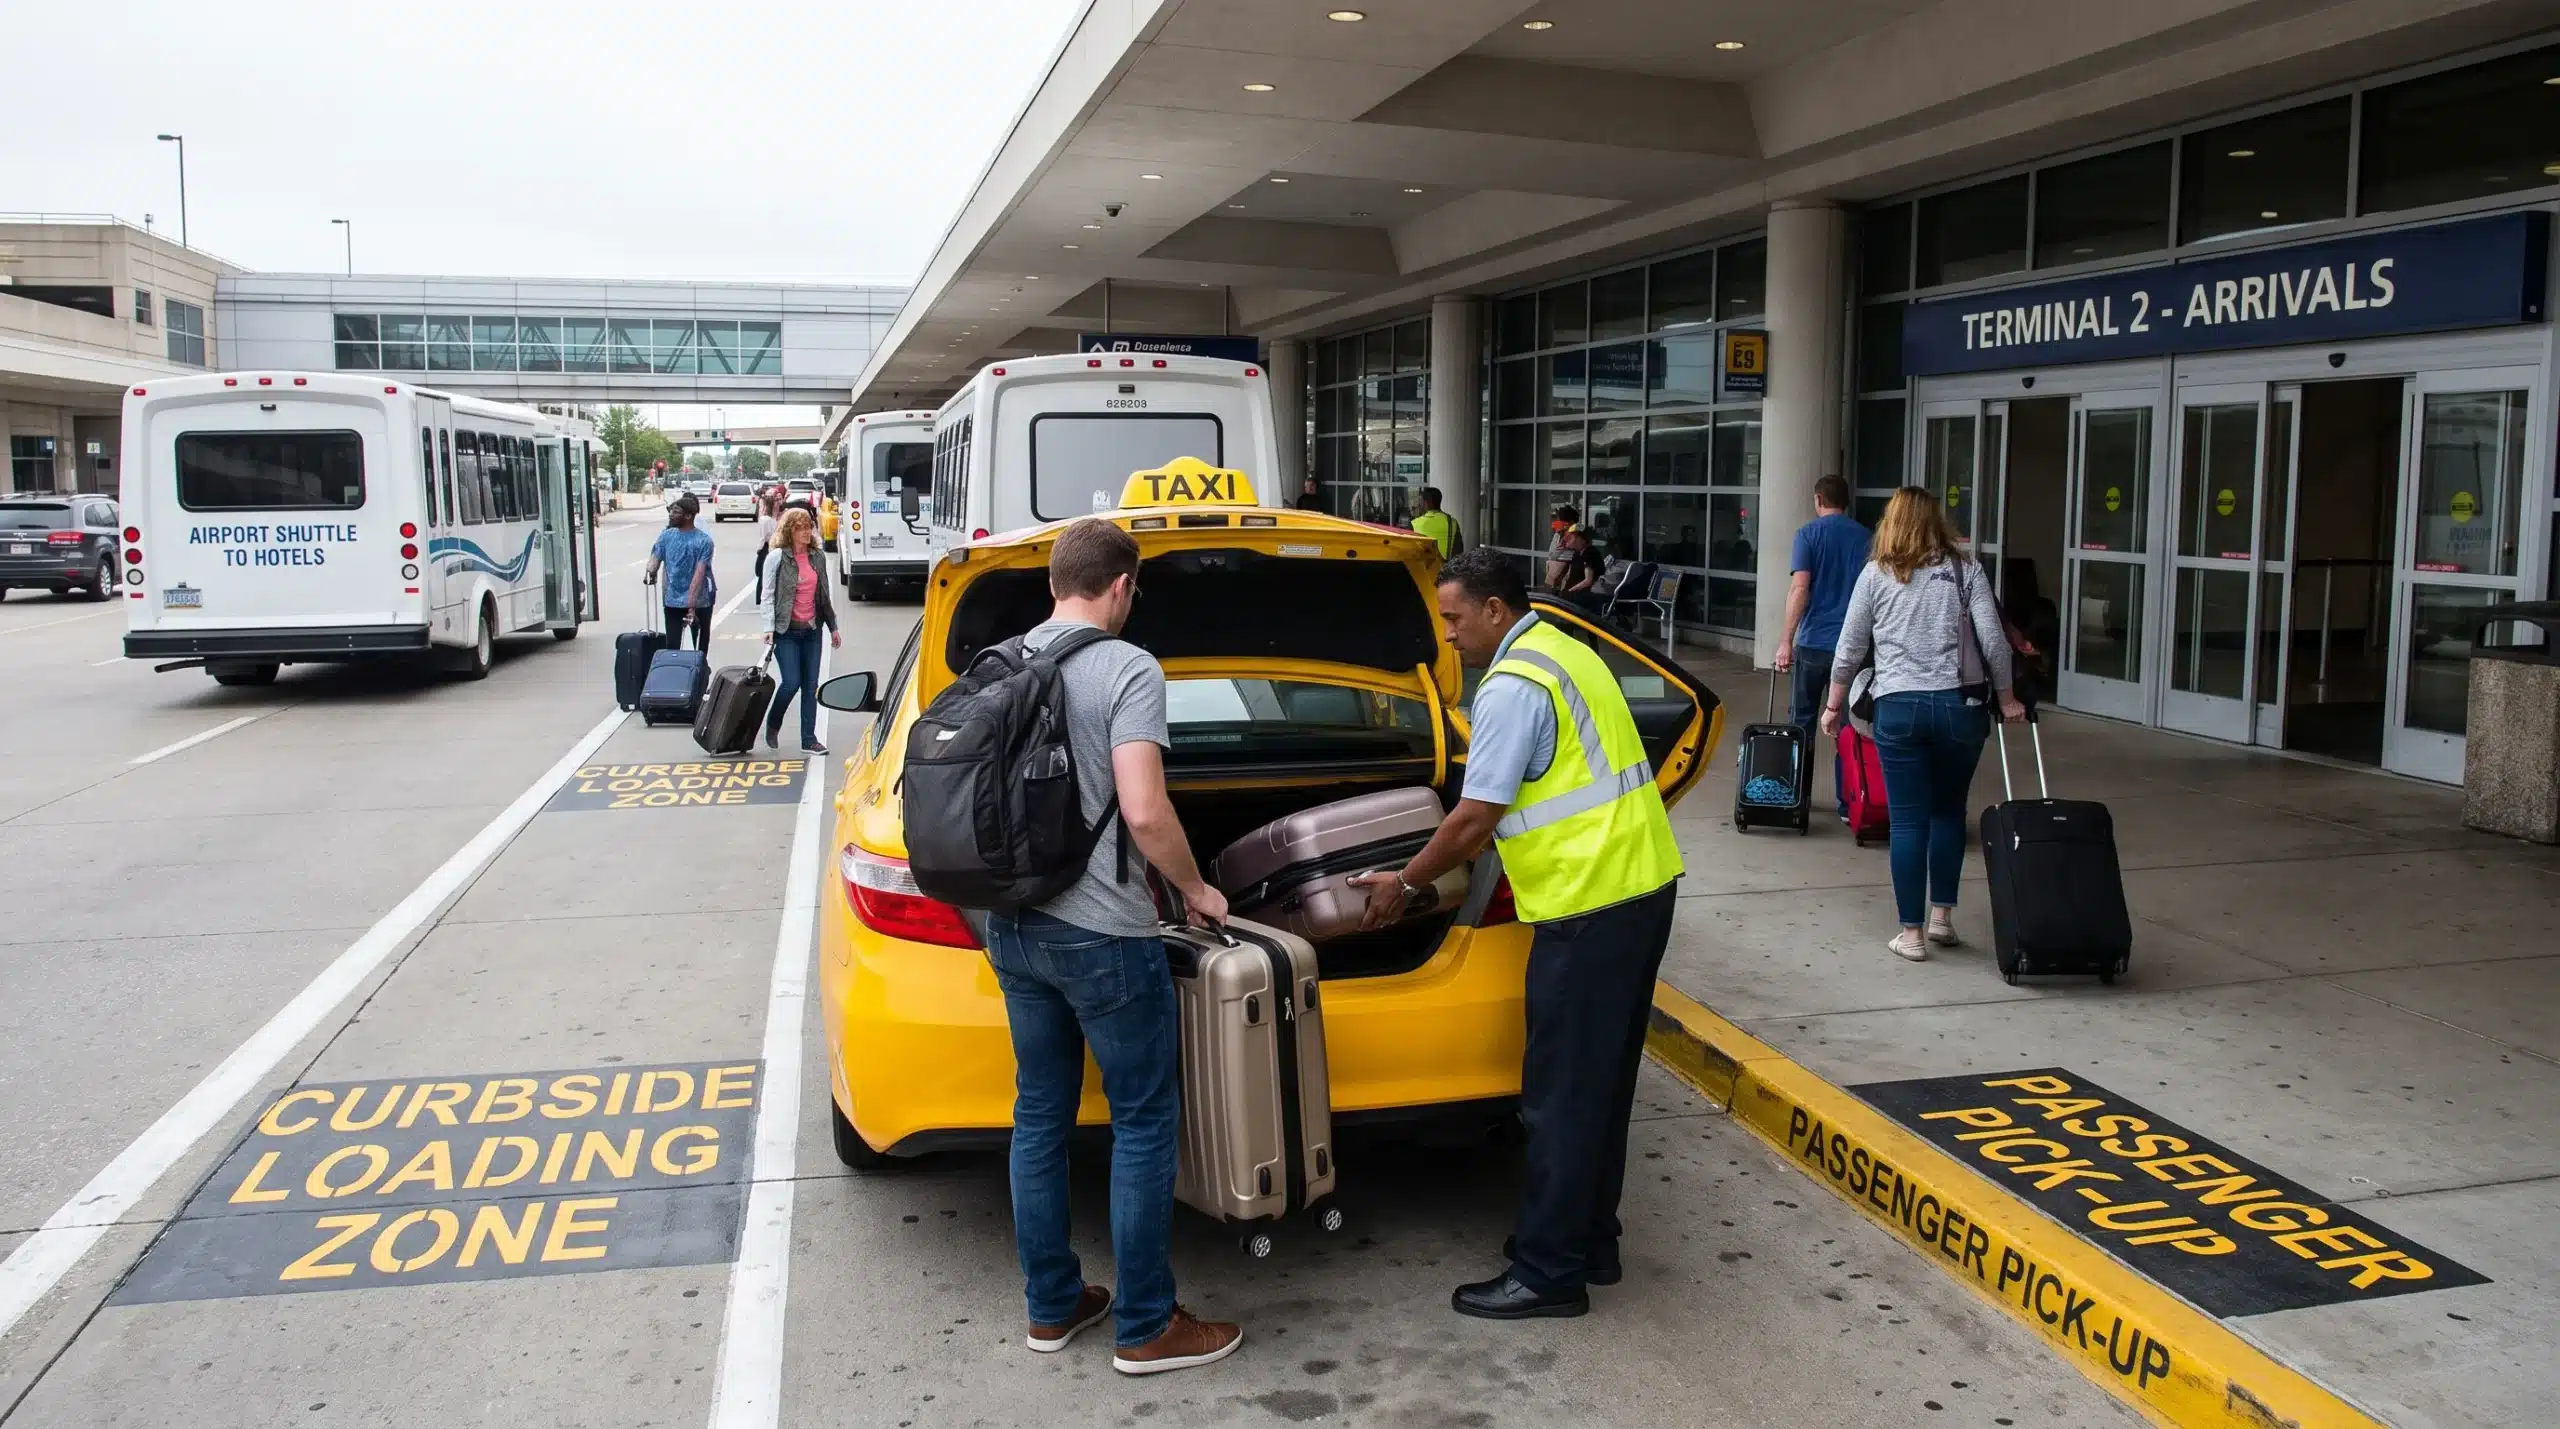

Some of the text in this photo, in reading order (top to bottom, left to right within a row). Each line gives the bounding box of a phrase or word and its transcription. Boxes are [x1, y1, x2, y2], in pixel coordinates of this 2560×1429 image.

[1962, 258, 2395, 350] TERMINAL 2 - ARRIVALS
[1143, 473, 1236, 501] TAXI
[189, 524, 357, 544] AIRPORT SHUTTLE
[223, 548, 325, 567] TO HOTELS
[575, 760, 805, 778] CURBSIDE
[577, 774, 792, 793] LOADING
[608, 789, 749, 809] ZONE
[256, 1064, 757, 1136] CURBSIDE
[227, 1124, 721, 1204] LOADING
[1918, 1105, 2238, 1257] PICK-UP
[1982, 1074, 2435, 1290] PASSENGER
[279, 1196, 619, 1281] ZONE
[1787, 1105, 2171, 1391] PASSENGER PICK-UP
